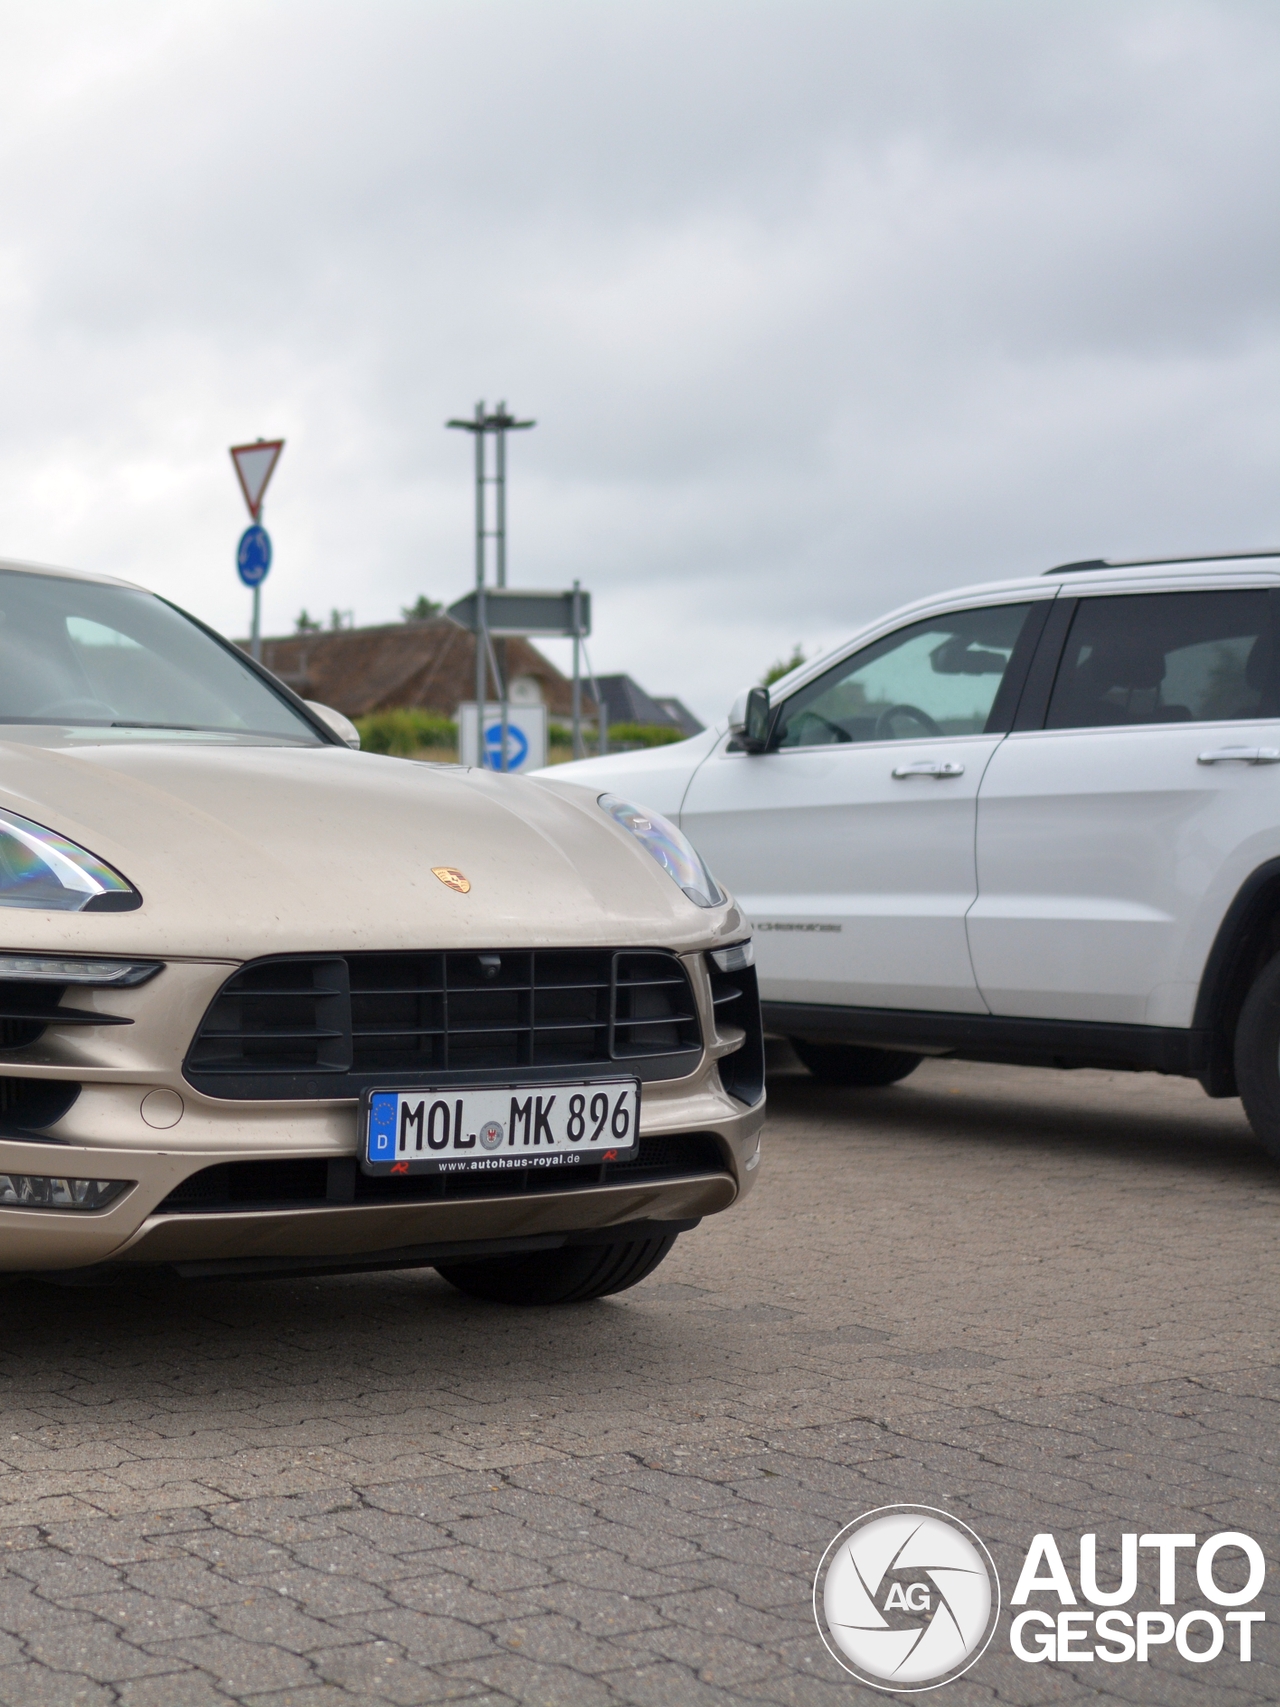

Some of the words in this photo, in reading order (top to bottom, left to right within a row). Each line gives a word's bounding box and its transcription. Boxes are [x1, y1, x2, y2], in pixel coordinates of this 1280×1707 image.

[399, 1099, 476, 1151] MOL
[508, 1095, 556, 1146] MK
[567, 1091, 630, 1142] 896
[377, 1134, 388, 1150] D
[438, 1154, 580, 1171] www.autohaus-royal.de
